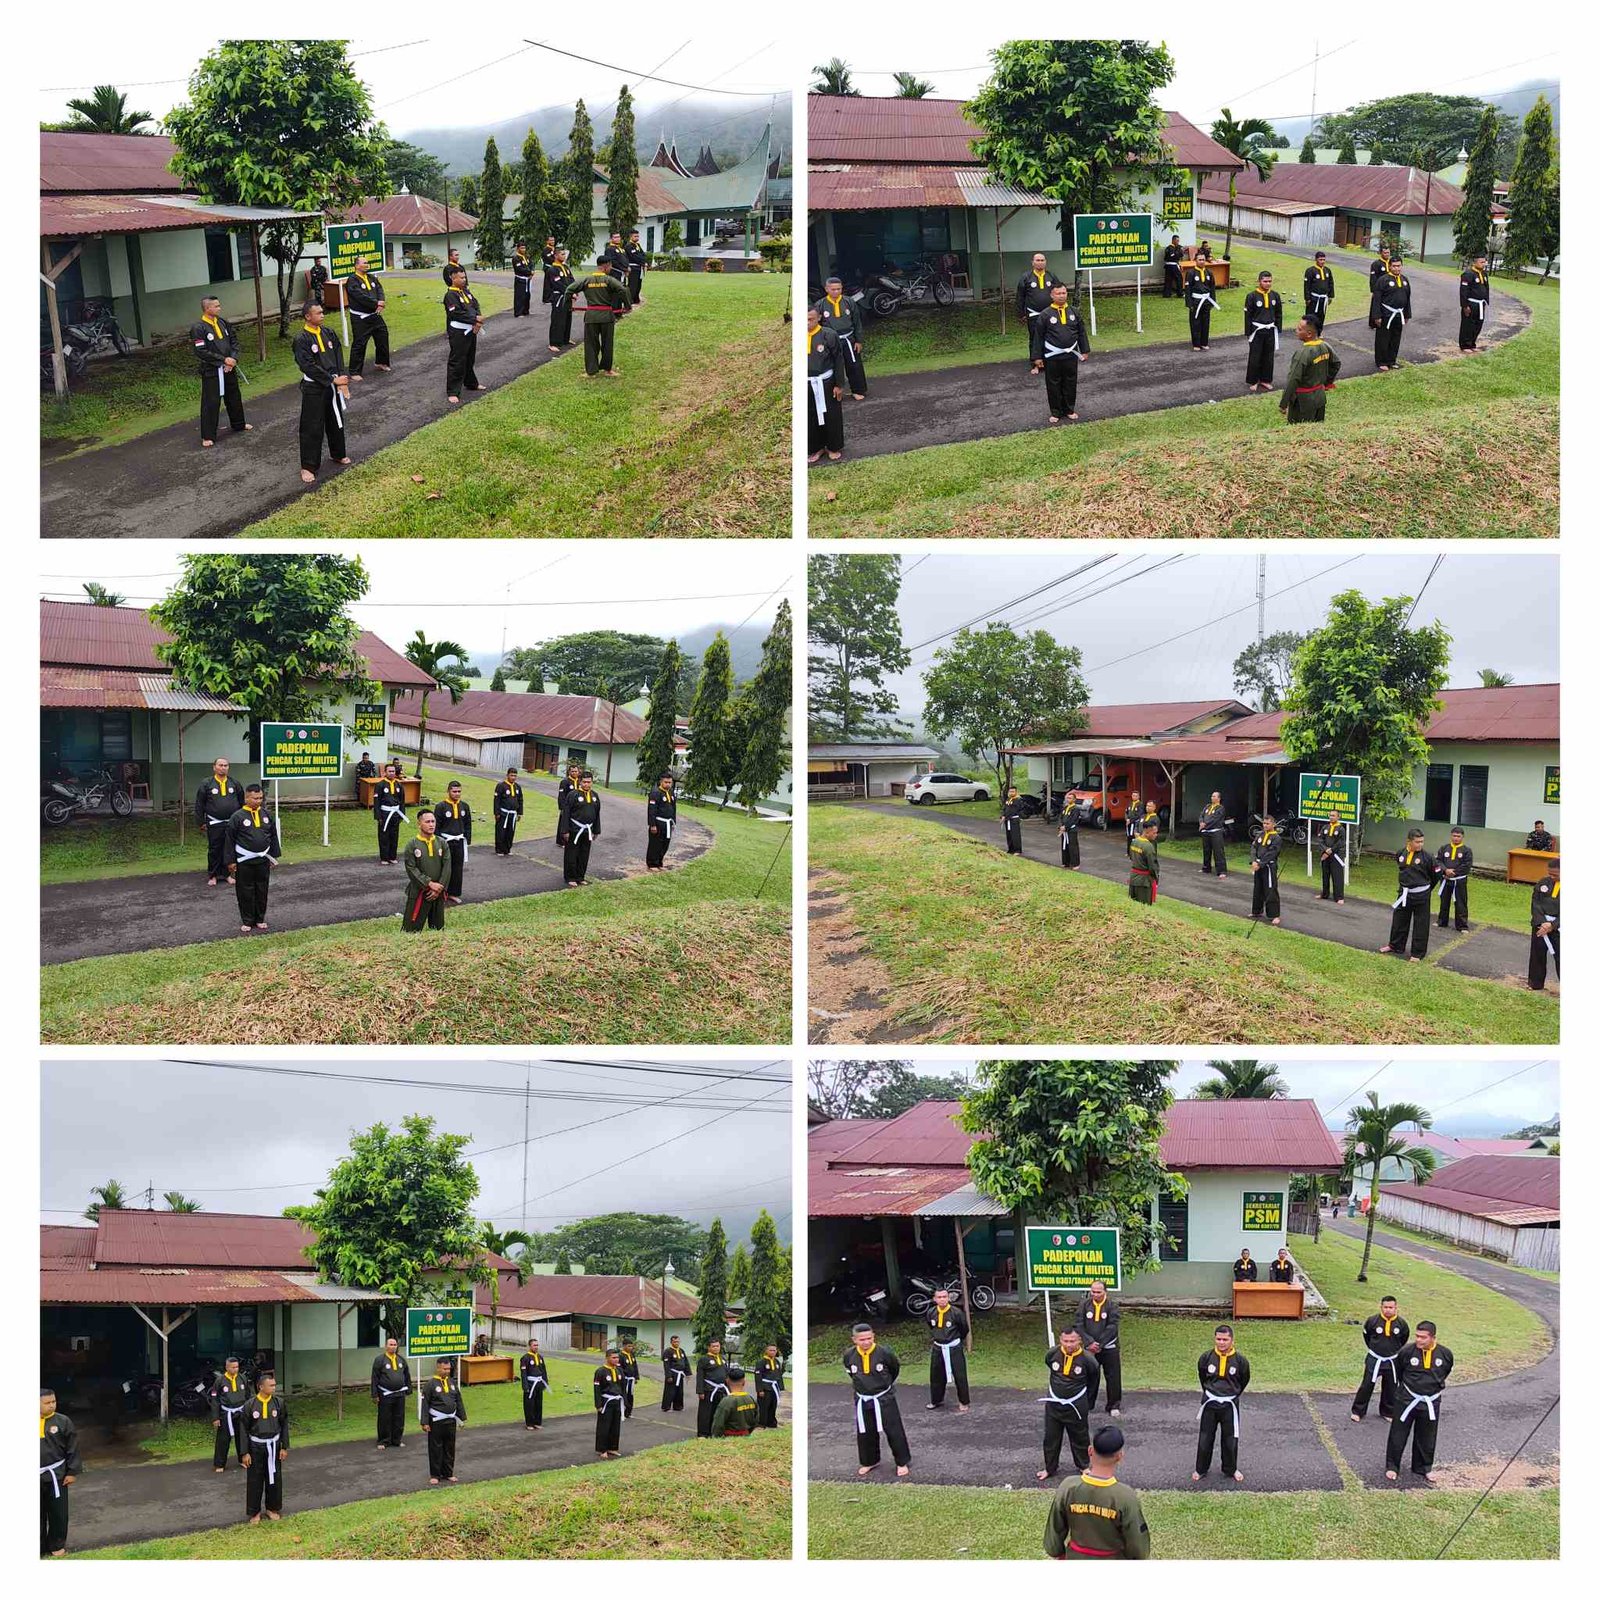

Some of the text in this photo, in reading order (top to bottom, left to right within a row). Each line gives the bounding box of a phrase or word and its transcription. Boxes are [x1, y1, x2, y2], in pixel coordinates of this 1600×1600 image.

[1164, 202, 1192, 214] PSM
[1089, 232, 1140, 244] PADEPOKAN
[338, 241, 375, 255] PADEPOKAN
[1080, 244, 1148, 256] PENCAK SILAT MILITER
[356, 718, 384, 730] PSM
[276, 743, 329, 754] PADEPOKAN
[266, 756, 338, 765] PENCAK SILAT MILITER
[1245, 1210, 1280, 1224] PSM
[1043, 1250, 1103, 1262] PADEPOKAN
[1034, 1264, 1114, 1275] PENCAK SILAT MILITER
[418, 1324, 460, 1336] PADEPOKAN
[410, 1335, 468, 1346] PENCAK SILAT MILITER
[1070, 1503, 1089, 1514] PENCAK
